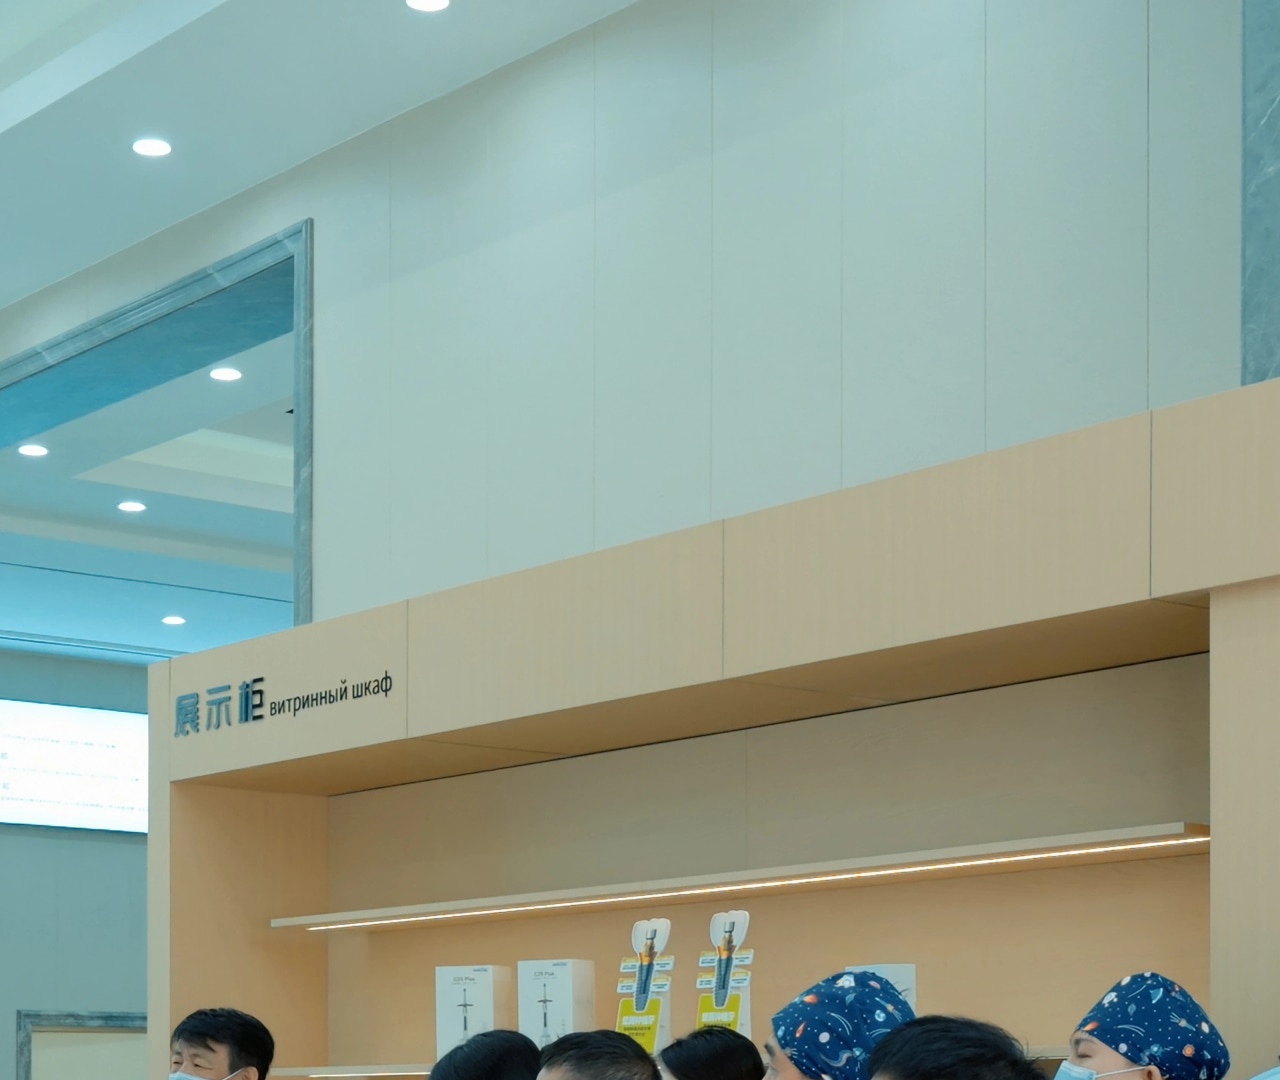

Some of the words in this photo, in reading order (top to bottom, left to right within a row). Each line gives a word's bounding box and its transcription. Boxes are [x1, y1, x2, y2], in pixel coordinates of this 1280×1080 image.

[174, 677, 264, 738] 展示柜
[269, 679, 348, 717] витринный
[352, 670, 393, 699] шкаф
